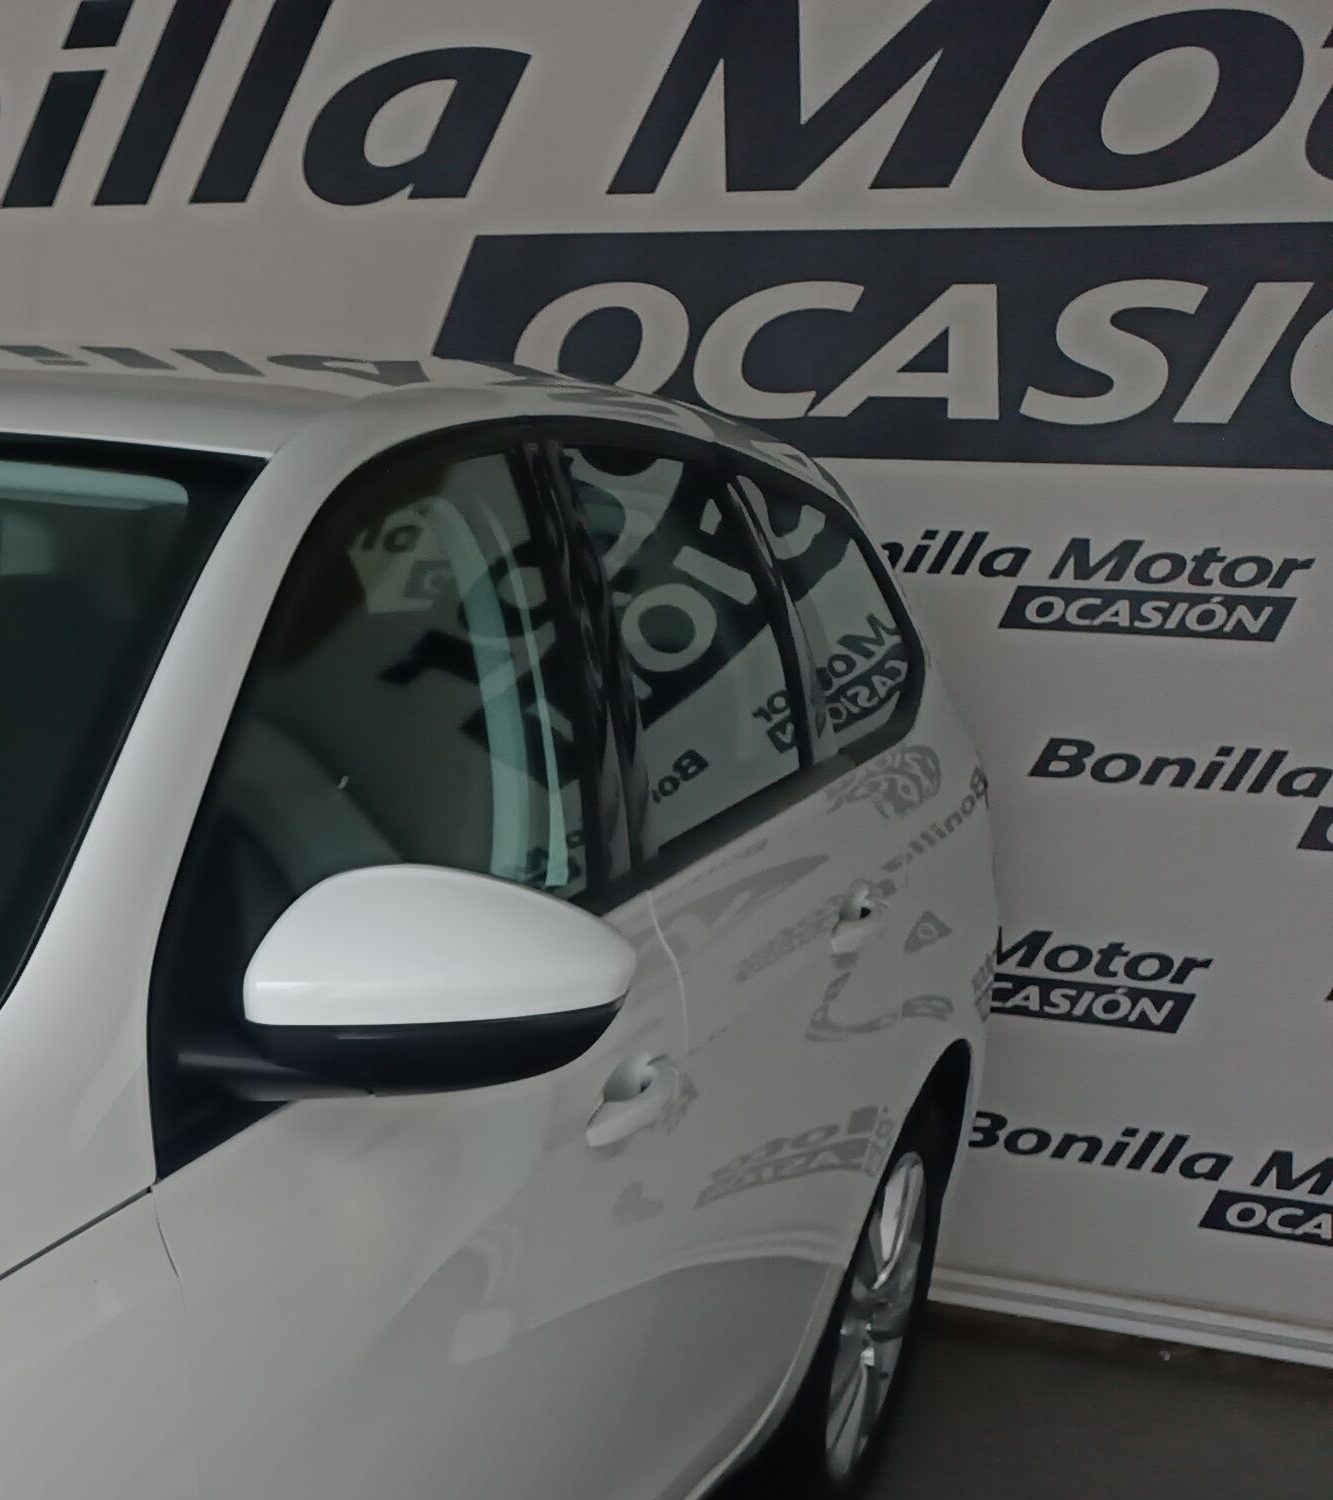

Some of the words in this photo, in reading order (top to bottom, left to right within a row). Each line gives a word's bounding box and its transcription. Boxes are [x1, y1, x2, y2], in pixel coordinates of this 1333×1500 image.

[606, 0, 1333, 196] Mo
[514, 278, 1333, 426] OCASI
[1048, 537, 1316, 589] Motor
[1024, 595, 1274, 634] OCASIÓN
[1028, 737, 1333, 798] Bonilla
[996, 926, 1214, 984] Motor
[968, 1111, 1233, 1181] Bonilla
